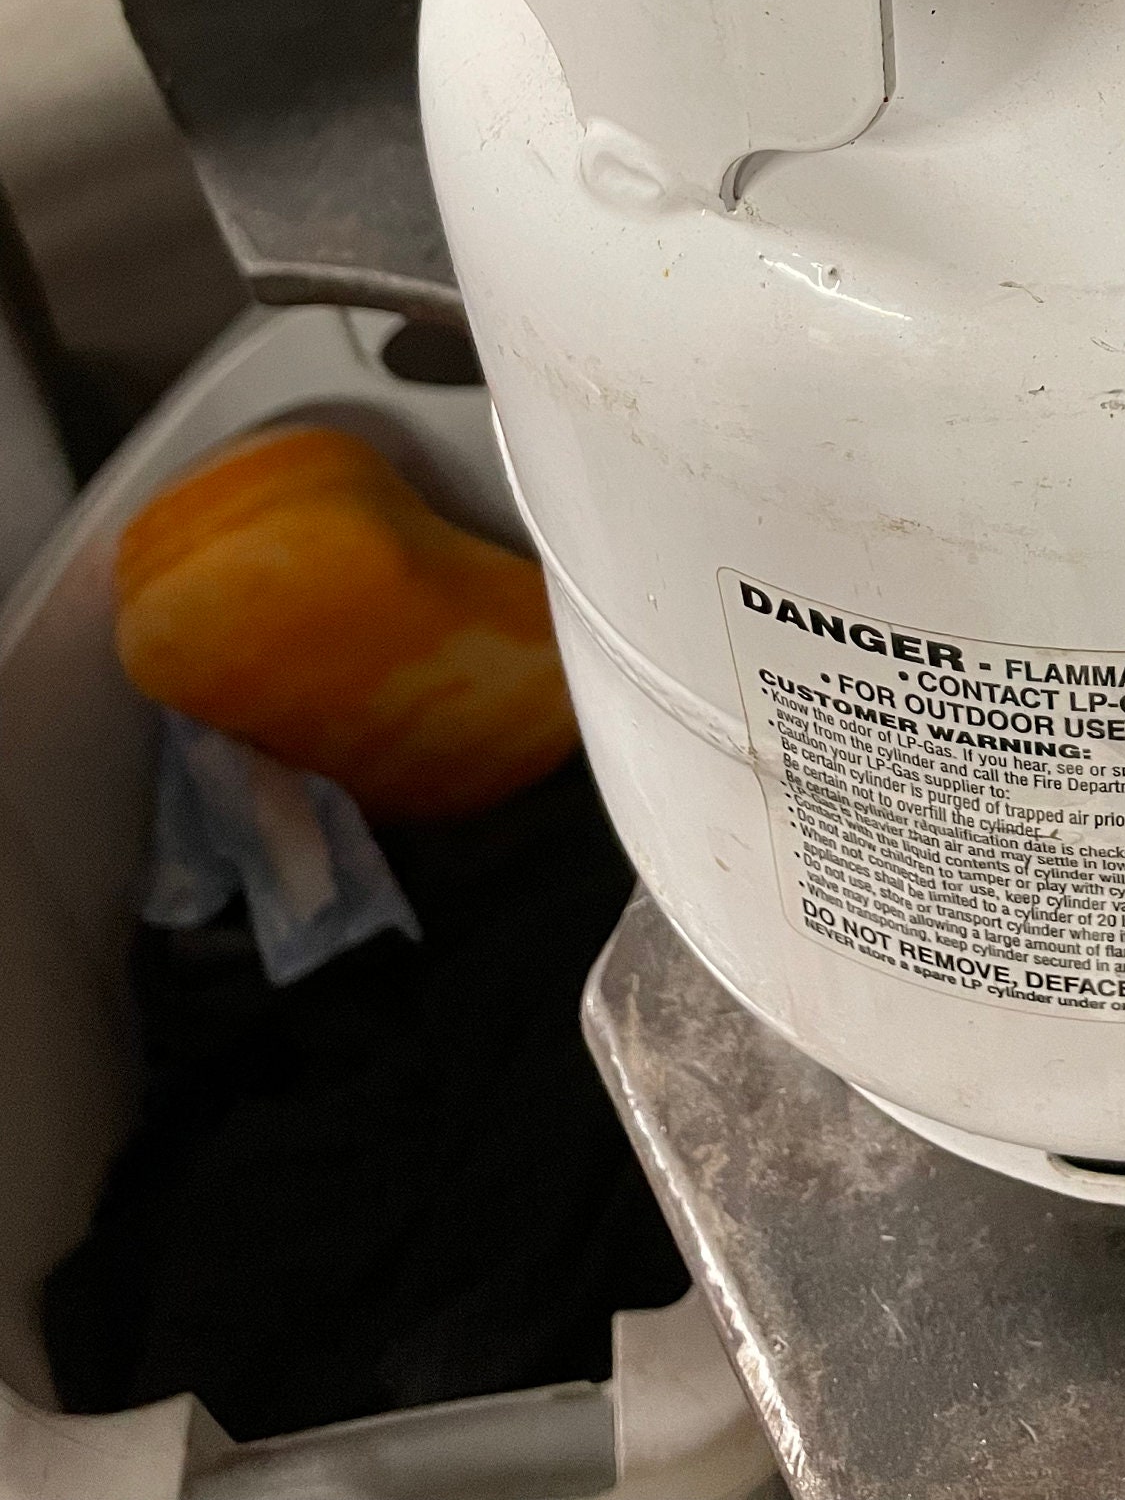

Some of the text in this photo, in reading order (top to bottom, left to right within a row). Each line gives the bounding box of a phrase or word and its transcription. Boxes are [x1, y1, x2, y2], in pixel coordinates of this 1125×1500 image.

[740, 580, 966, 672] DANGER
[759, 669, 1091, 760] CUSTOMER WARNING:
[838, 673, 896, 709] FOR
[905, 693, 1055, 736] OUTDOOR
[917, 671, 1060, 710] CONTACT
[771, 688, 809, 715] Know
[813, 706, 834, 725] the
[840, 717, 872, 738] odor
[878, 729, 891, 744] of
[978, 753, 1007, 768] you
[1014, 756, 1051, 775] hear,
[1057, 764, 1083, 775] see
[1090, 765, 1106, 777] or
[777, 708, 809, 731] away
[813, 722, 846, 745] from
[851, 737, 872, 753] the
[878, 745, 935, 770] cylinder
[940, 761, 967, 777] and
[973, 766, 999, 782] call
[1004, 771, 1028, 786] the
[1034, 774, 1062, 790] Fire
[777, 721, 985, 795] Caution your LP-Gas supplier
[802, 749, 846, 776] certain
[850, 767, 906, 794] cylinder
[928, 789, 980, 811] purged
[1005, 802, 1064, 824] trapped
[1069, 810, 1089, 826] air
[803, 763, 975, 827] certain not overfill the
[806, 781, 850, 807] certain
[854, 801, 908, 826] cylinder
[914, 817, 1019, 850] requalification
[1024, 838, 1056, 855] date
[868, 853, 935, 889] connected
[880, 847, 1011, 888] children tamper
[802, 897, 835, 927] DO
[842, 916, 892, 950] NOT
[899, 938, 1018, 988] REMOVE,
[936, 903, 1003, 930] transport
[1097, 913, 1117, 928] 20
[804, 915, 854, 949] NEVER
[987, 983, 1052, 1004] cylinder
[1058, 996, 1105, 1010] under
[1033, 953, 1091, 971] secured
